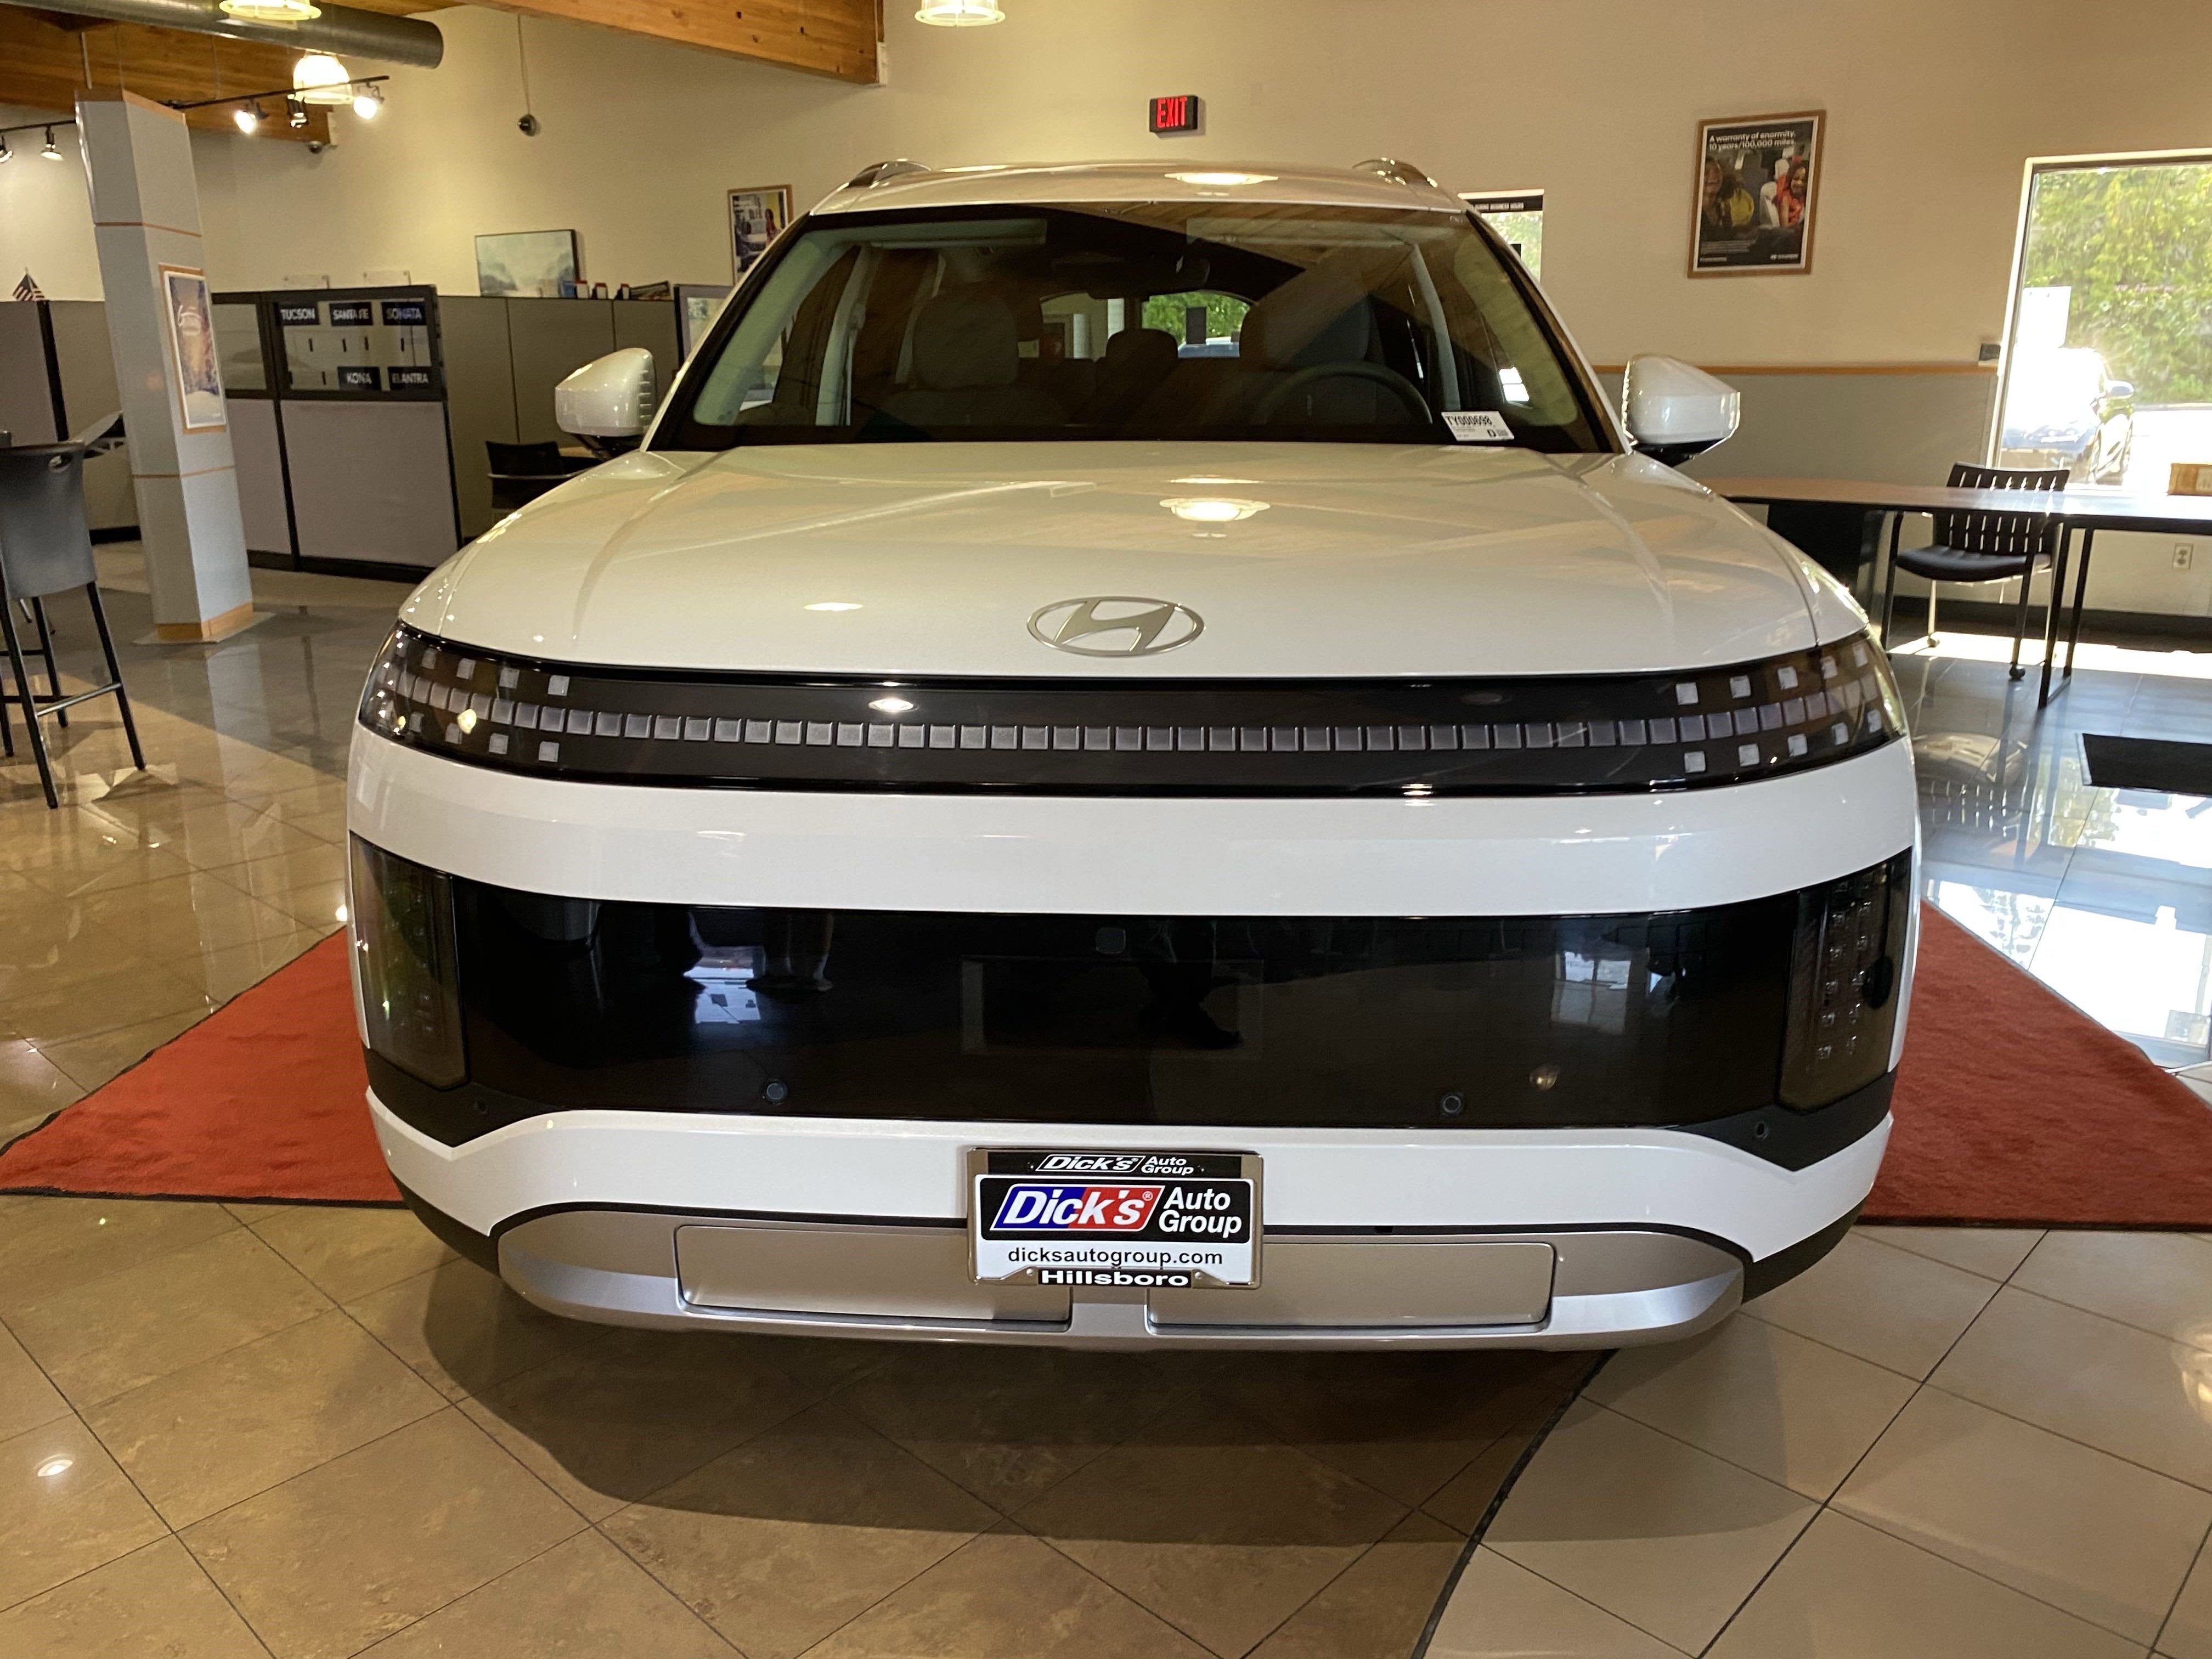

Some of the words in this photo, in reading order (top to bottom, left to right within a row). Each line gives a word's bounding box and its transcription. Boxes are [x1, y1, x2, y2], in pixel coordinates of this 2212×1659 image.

[1157, 97, 1187, 128] EXIT
[1716, 134, 1750, 142] warranty
[1709, 143, 1717, 151] 10
[280, 308, 316, 320] TUCSON
[333, 308, 358, 320] SANTA
[358, 308, 369, 319] FE
[386, 308, 422, 320] SONATA
[347, 373, 372, 384] KONA
[392, 373, 428, 383] ELANTRA
[1445, 415, 1492, 426] TY000698
[1486, 429, 1496, 437] D
[1145, 1156, 1187, 1166] Auto
[1141, 1164, 1194, 1176] Group
[1163, 1187, 1231, 1210] Auto
[1159, 1210, 1242, 1239] Group
[1008, 1247, 1223, 1268] dicksautogroup.com
[1041, 1269, 1189, 1287] Hillsboro
